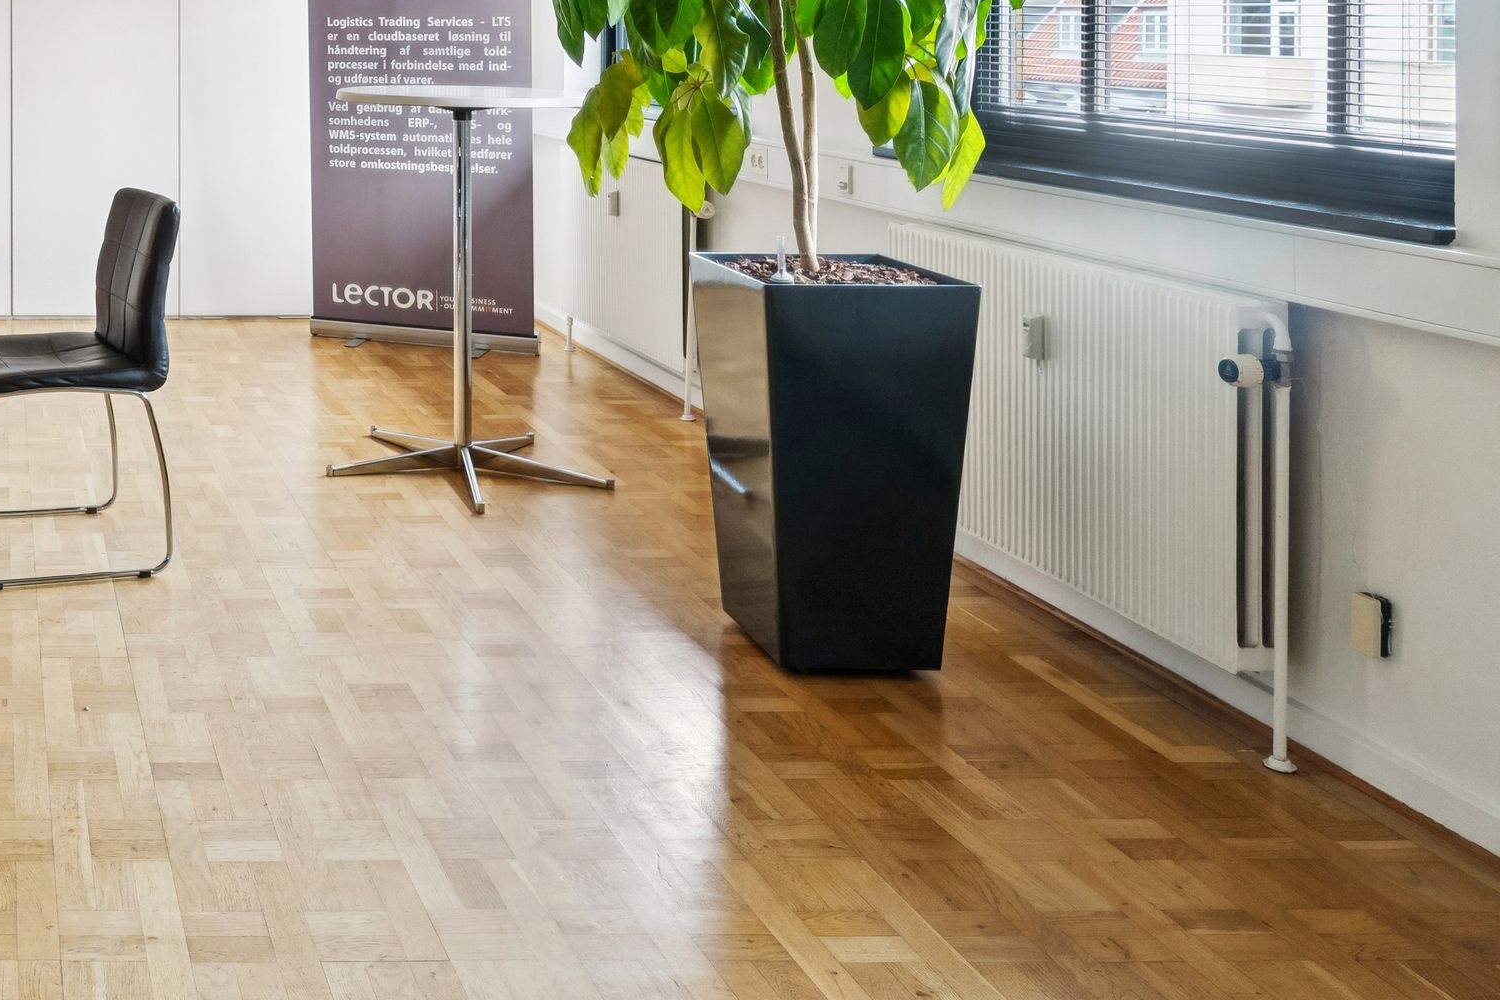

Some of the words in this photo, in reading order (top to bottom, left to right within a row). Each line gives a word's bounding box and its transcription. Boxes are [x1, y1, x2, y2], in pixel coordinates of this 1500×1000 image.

[327, 17, 373, 29] Logistics
[378, 16, 420, 29] Trading
[428, 16, 473, 26] Services
[492, 17, 511, 26] LTS
[368, 31, 439, 41] cloudbaseret
[449, 31, 490, 44] løsning
[499, 31, 511, 41] til
[328, 45, 386, 57] håndtering
[400, 45, 410, 55] af
[423, 46, 471, 58] samtlige
[484, 46, 511, 56] told-
[328, 62, 378, 71] processer
[391, 60, 454, 70] forbindelse
[459, 60, 483, 71] med
[489, 60, 511, 71] ind-
[328, 76, 341, 85] og
[344, 74, 388, 84] udførsel
[390, 74, 401, 84] af
[329, 102, 348, 111] Ved
[357, 104, 402, 115] genbrug
[329, 116, 389, 126] somhedens
[408, 118, 437, 129] ERP-,
[497, 123, 511, 133] og
[329, 130, 396, 142] WMS-system
[488, 134, 512, 145] hele
[329, 144, 407, 157] toldprocessen,
[415, 146, 452, 157] hvilket
[329, 159, 356, 168] store
